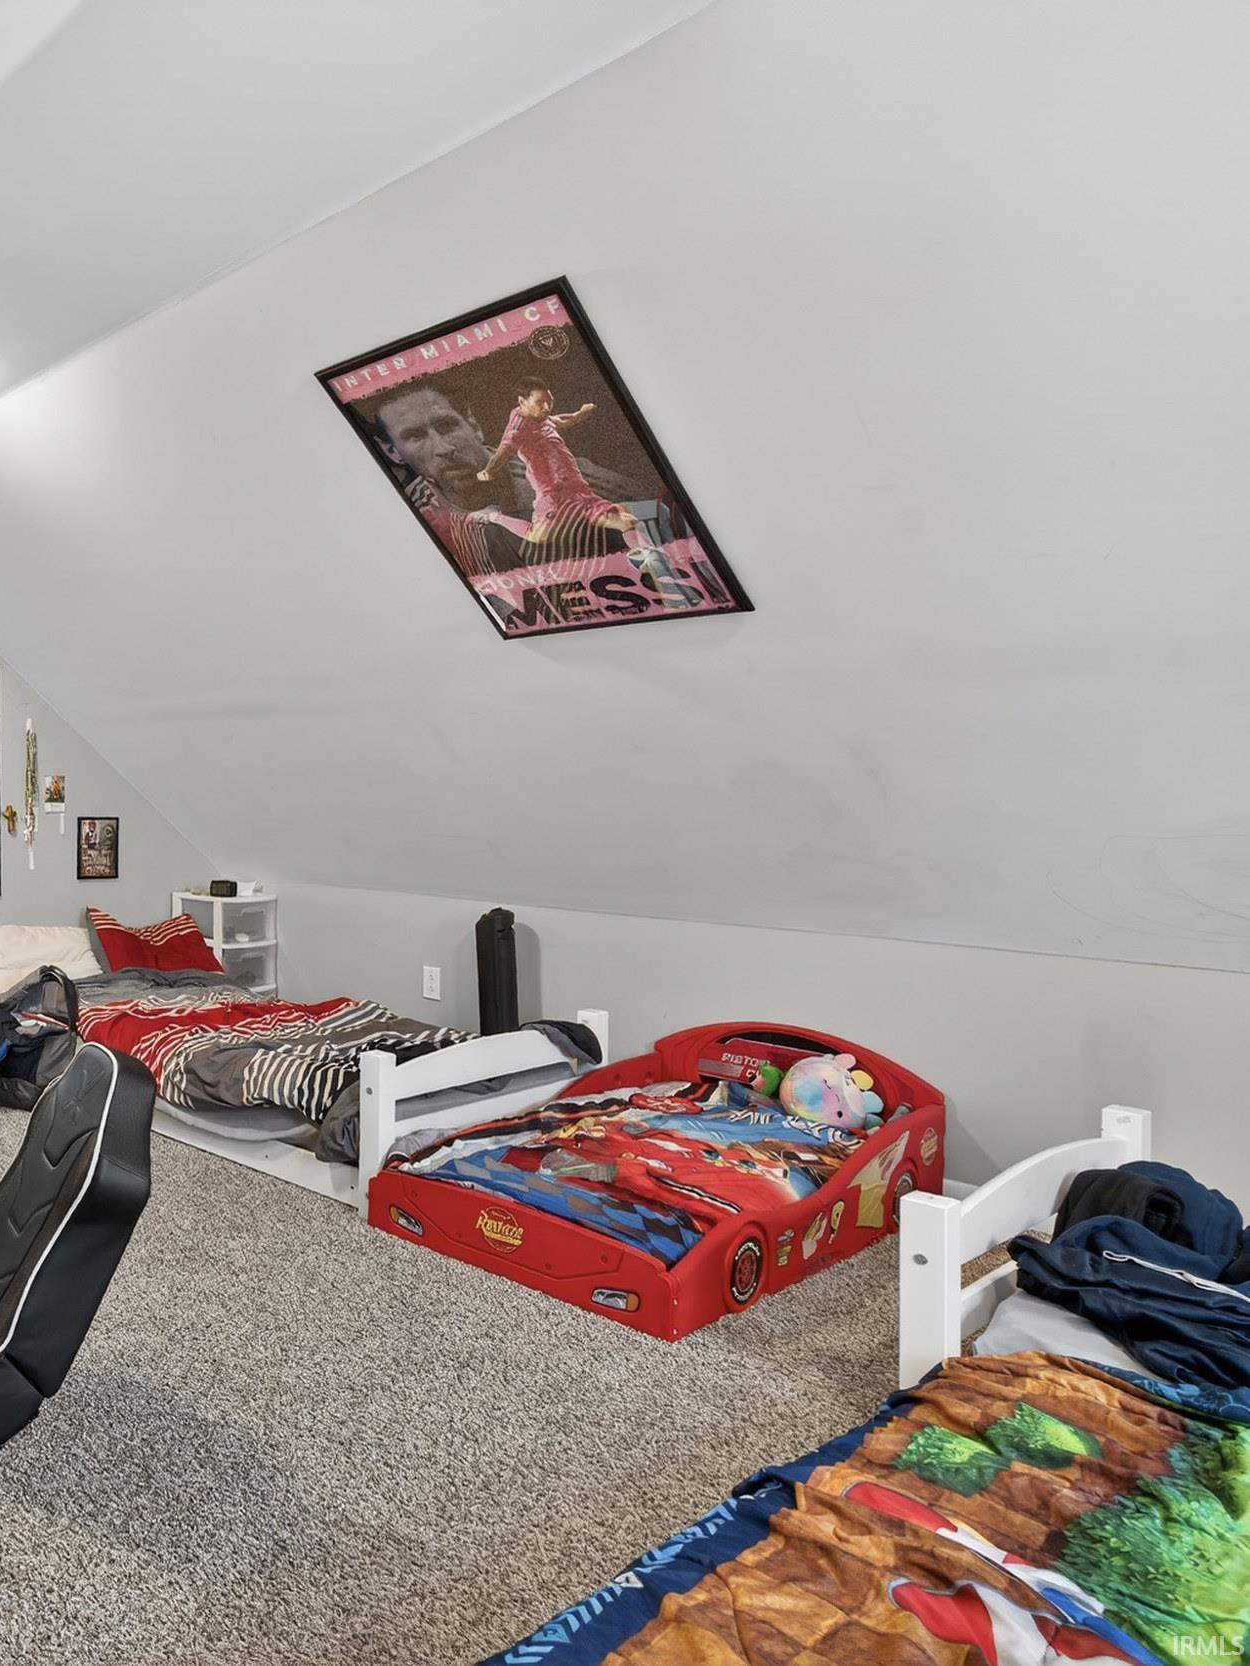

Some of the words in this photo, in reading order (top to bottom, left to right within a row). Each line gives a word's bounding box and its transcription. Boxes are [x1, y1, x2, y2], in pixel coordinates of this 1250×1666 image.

[332, 357, 407, 392] INTER
[419, 318, 508, 361] MIAMI
[523, 299, 560, 322] CF
[485, 562, 732, 629] MESSI
